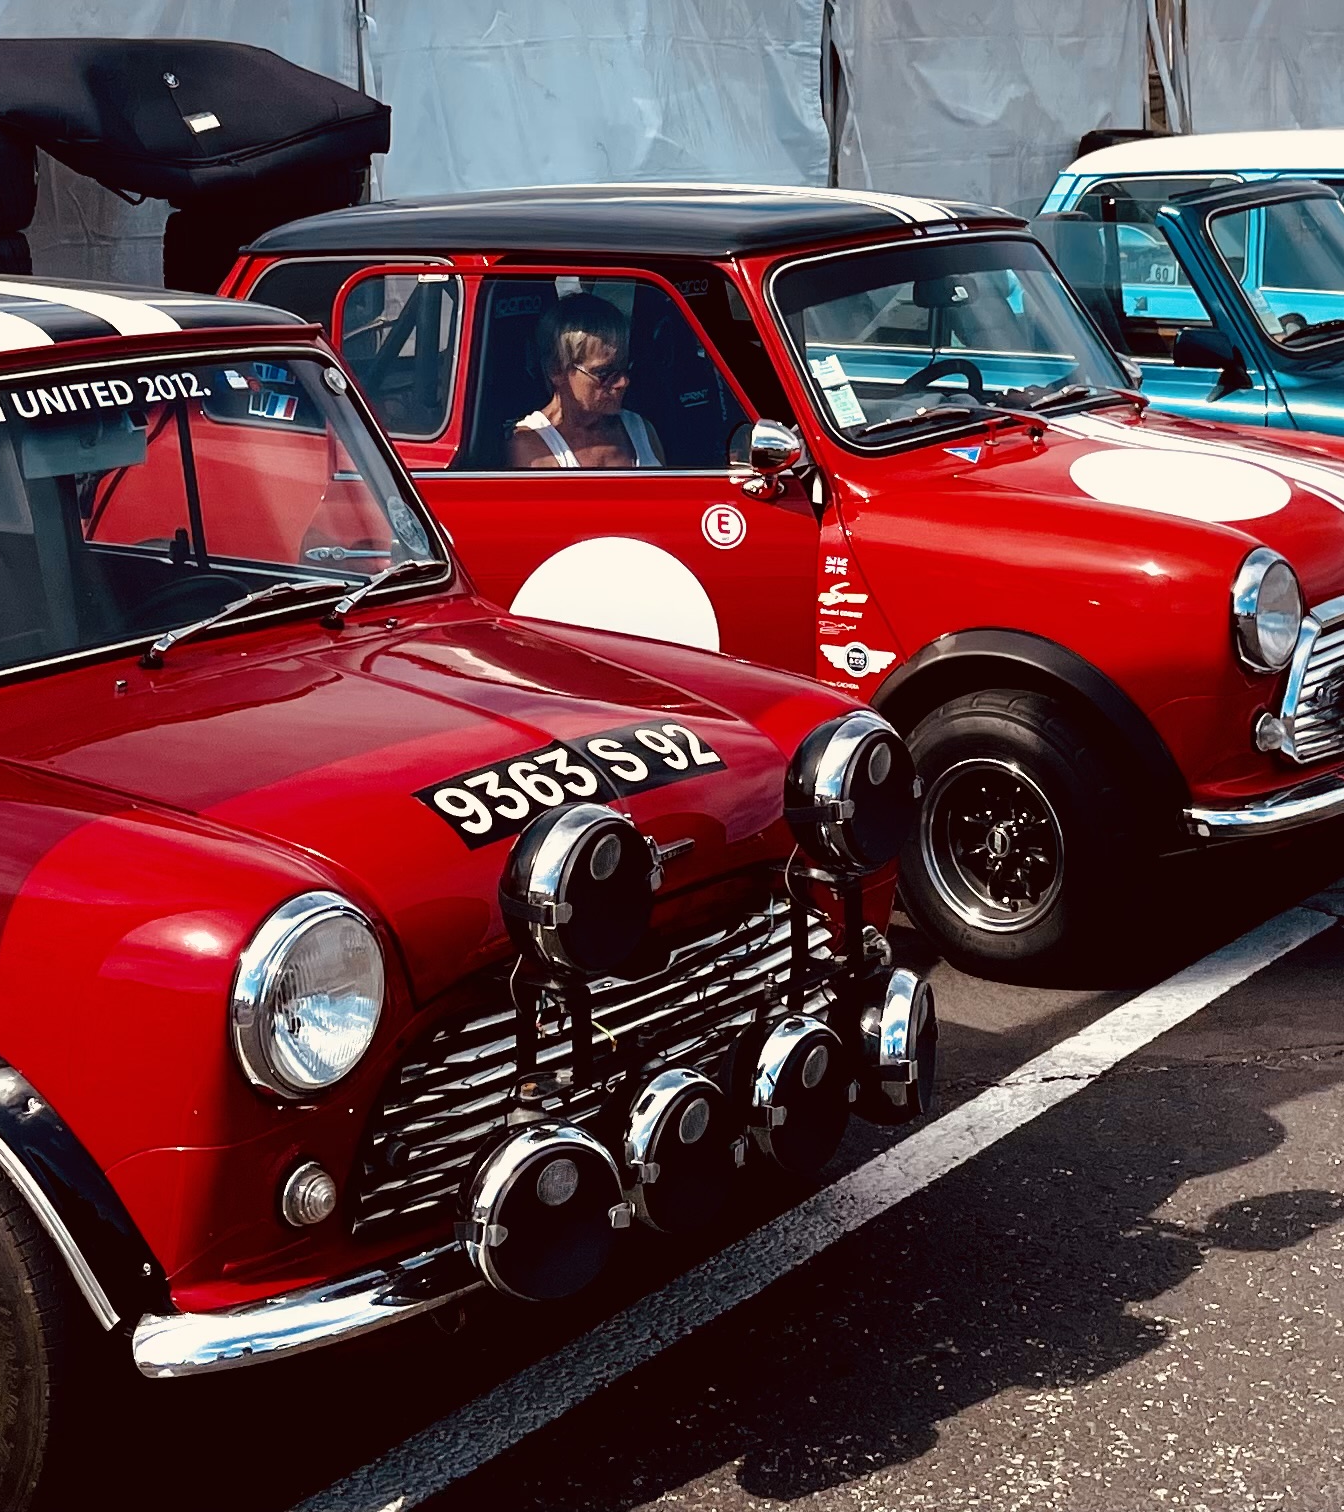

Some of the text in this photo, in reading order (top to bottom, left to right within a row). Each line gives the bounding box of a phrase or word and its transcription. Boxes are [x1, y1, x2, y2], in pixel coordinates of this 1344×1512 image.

[12, 379, 134, 419] UNITED
[717, 513, 731, 534] E
[432, 722, 721, 835] 9363 S 92
